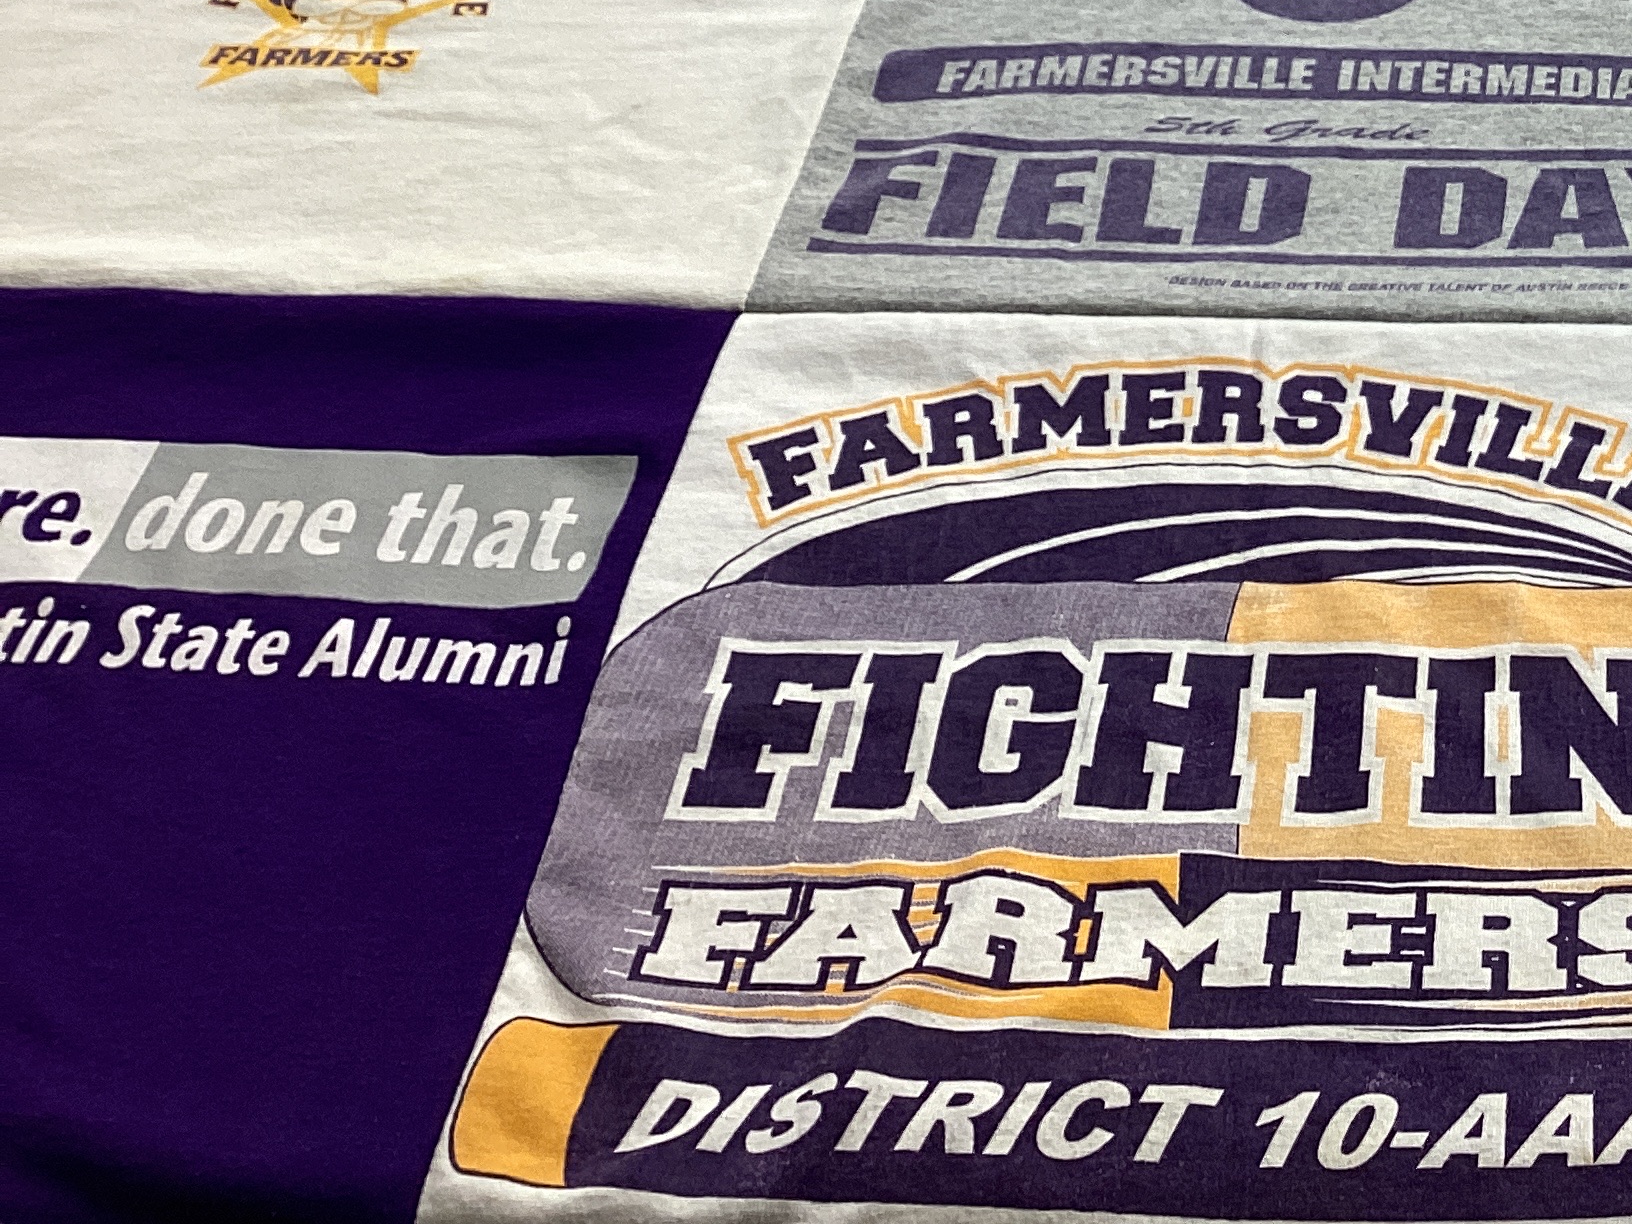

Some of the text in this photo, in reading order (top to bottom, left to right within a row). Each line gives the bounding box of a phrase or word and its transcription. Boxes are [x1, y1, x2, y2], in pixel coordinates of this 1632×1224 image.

[206, 44, 415, 69] FARMERS
[935, 52, 1315, 98] FARMERSVILLE
[1142, 114, 1431, 145] 5th Grade
[818, 147, 1313, 249] FIELD
[124, 471, 358, 557] done
[375, 483, 588, 573] that.
[100, 605, 291, 677] State
[298, 615, 573, 688] Alumni
[610, 1076, 1225, 1167] DISTRICT
